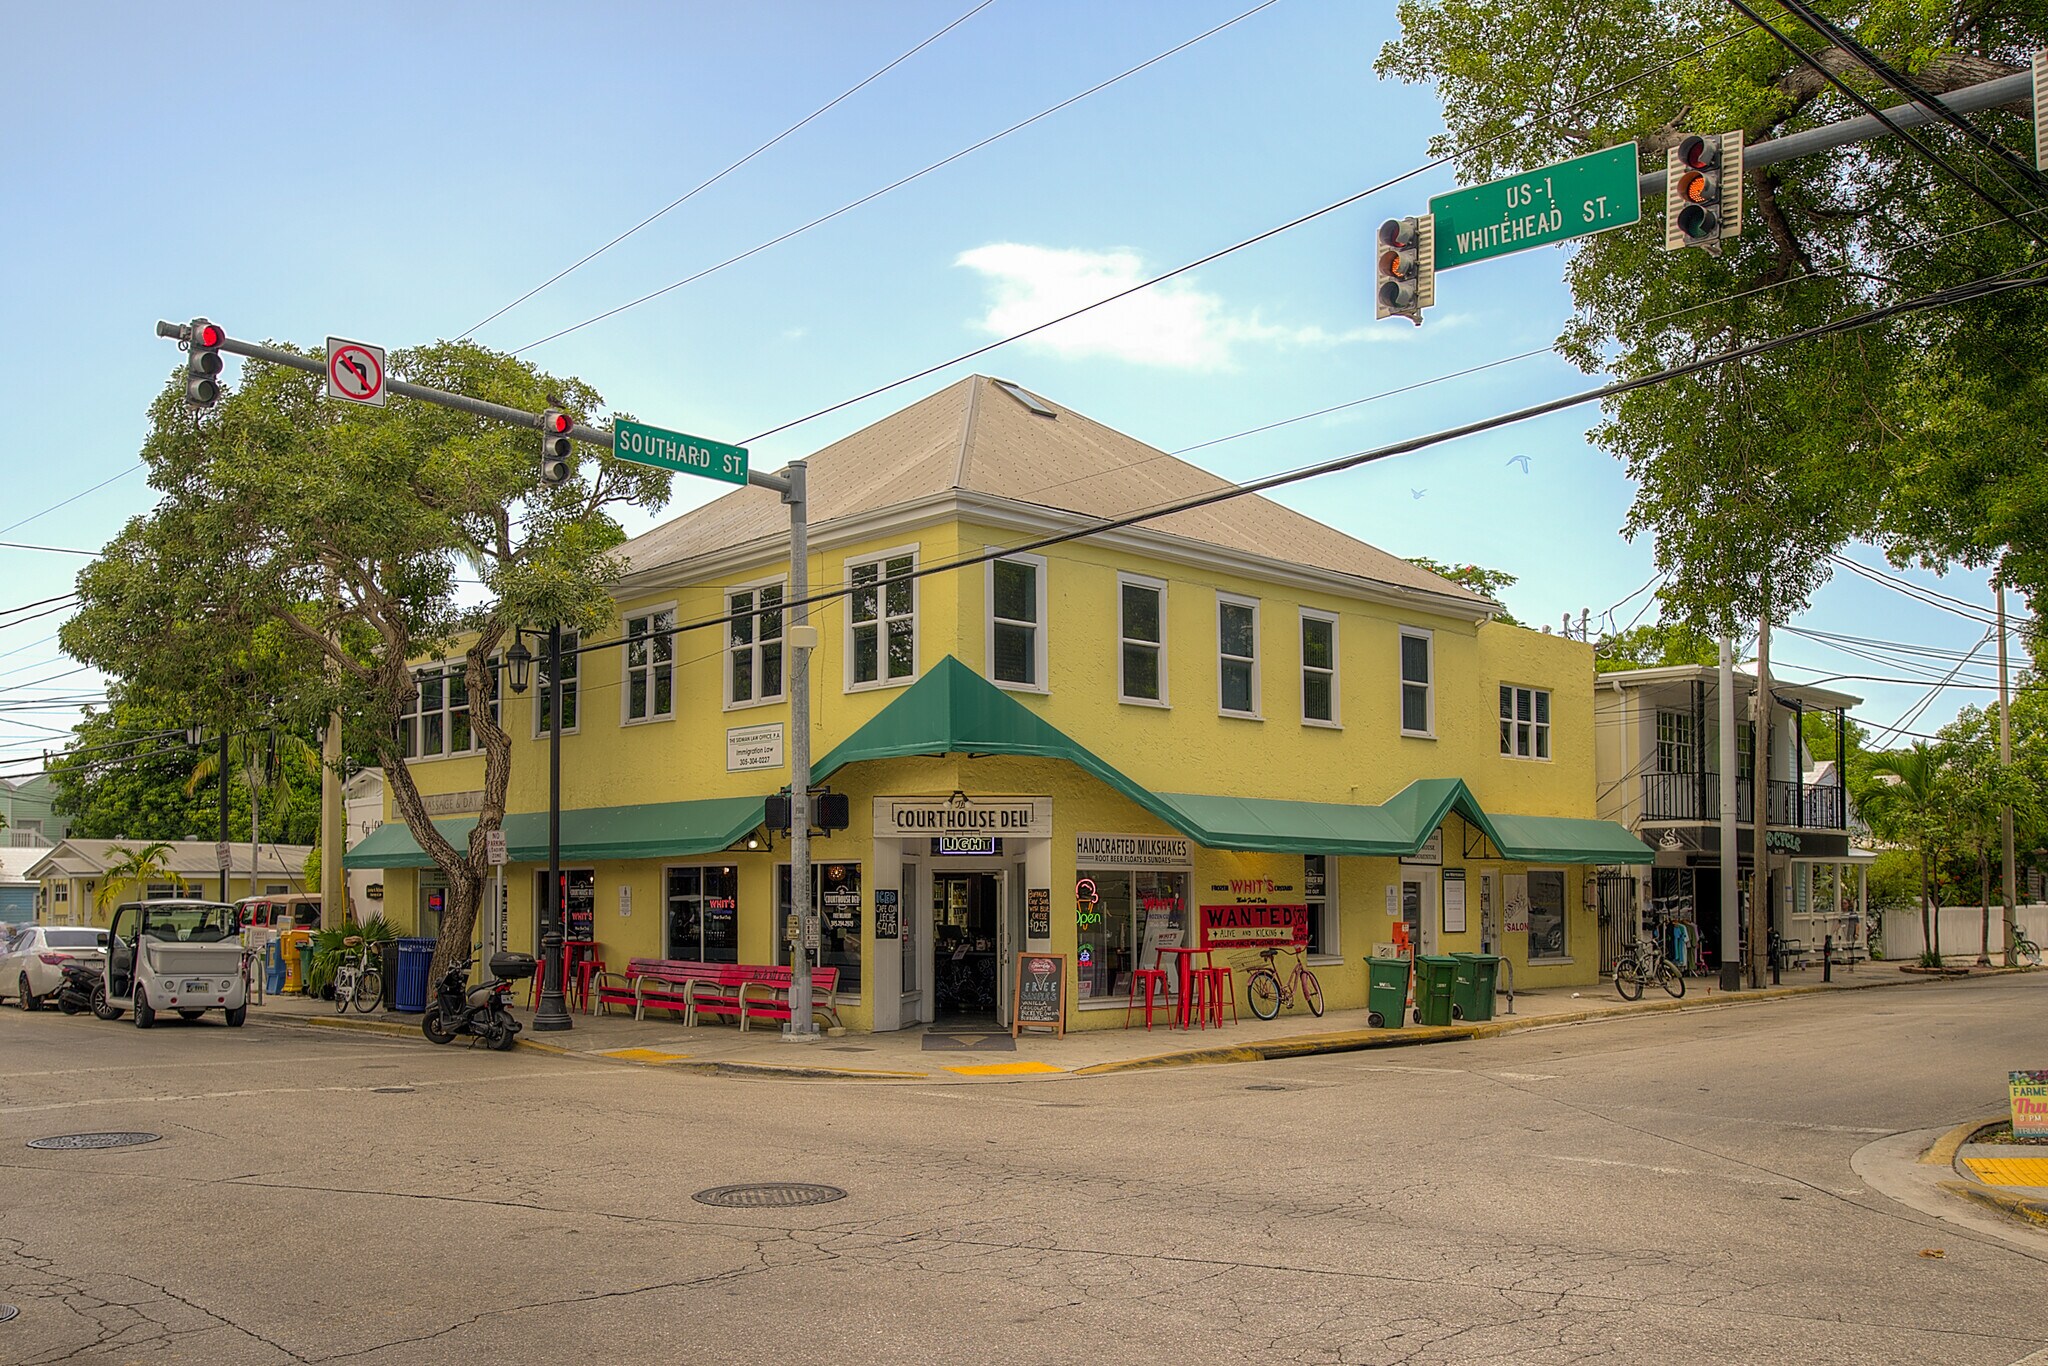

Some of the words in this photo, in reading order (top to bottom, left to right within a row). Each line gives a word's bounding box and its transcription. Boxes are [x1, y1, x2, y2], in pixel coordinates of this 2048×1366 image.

[1506, 177, 1552, 209] US-1
[1456, 208, 1563, 254] WHITEHEAD
[1583, 196, 1612, 223] ST.
[620, 430, 710, 467] SOUTHARD
[723, 454, 744, 476] ST.
[736, 747, 764, 756] Immigration
[463, 798, 476, 808] DAY
[897, 810, 995, 828] COURTHOUSE
[1001, 810, 1028, 828] DELI
[943, 838, 992, 850] LIGHT
[1077, 838, 1135, 854] HANDCRAFTED
[1138, 840, 1186, 856] MILKSHAKES
[1230, 878, 1274, 894] WHIT'S
[710, 897, 735, 909] WHIT'S
[876, 890, 896, 904] ICED
[572, 911, 592, 920] WHIT'S
[1207, 908, 1292, 927] WANTED
[1220, 930, 1236, 938] ALIVE
[1256, 929, 1277, 937] KICKING
[1507, 922, 1528, 932] SALON
[1025, 982, 1057, 992] FREE
